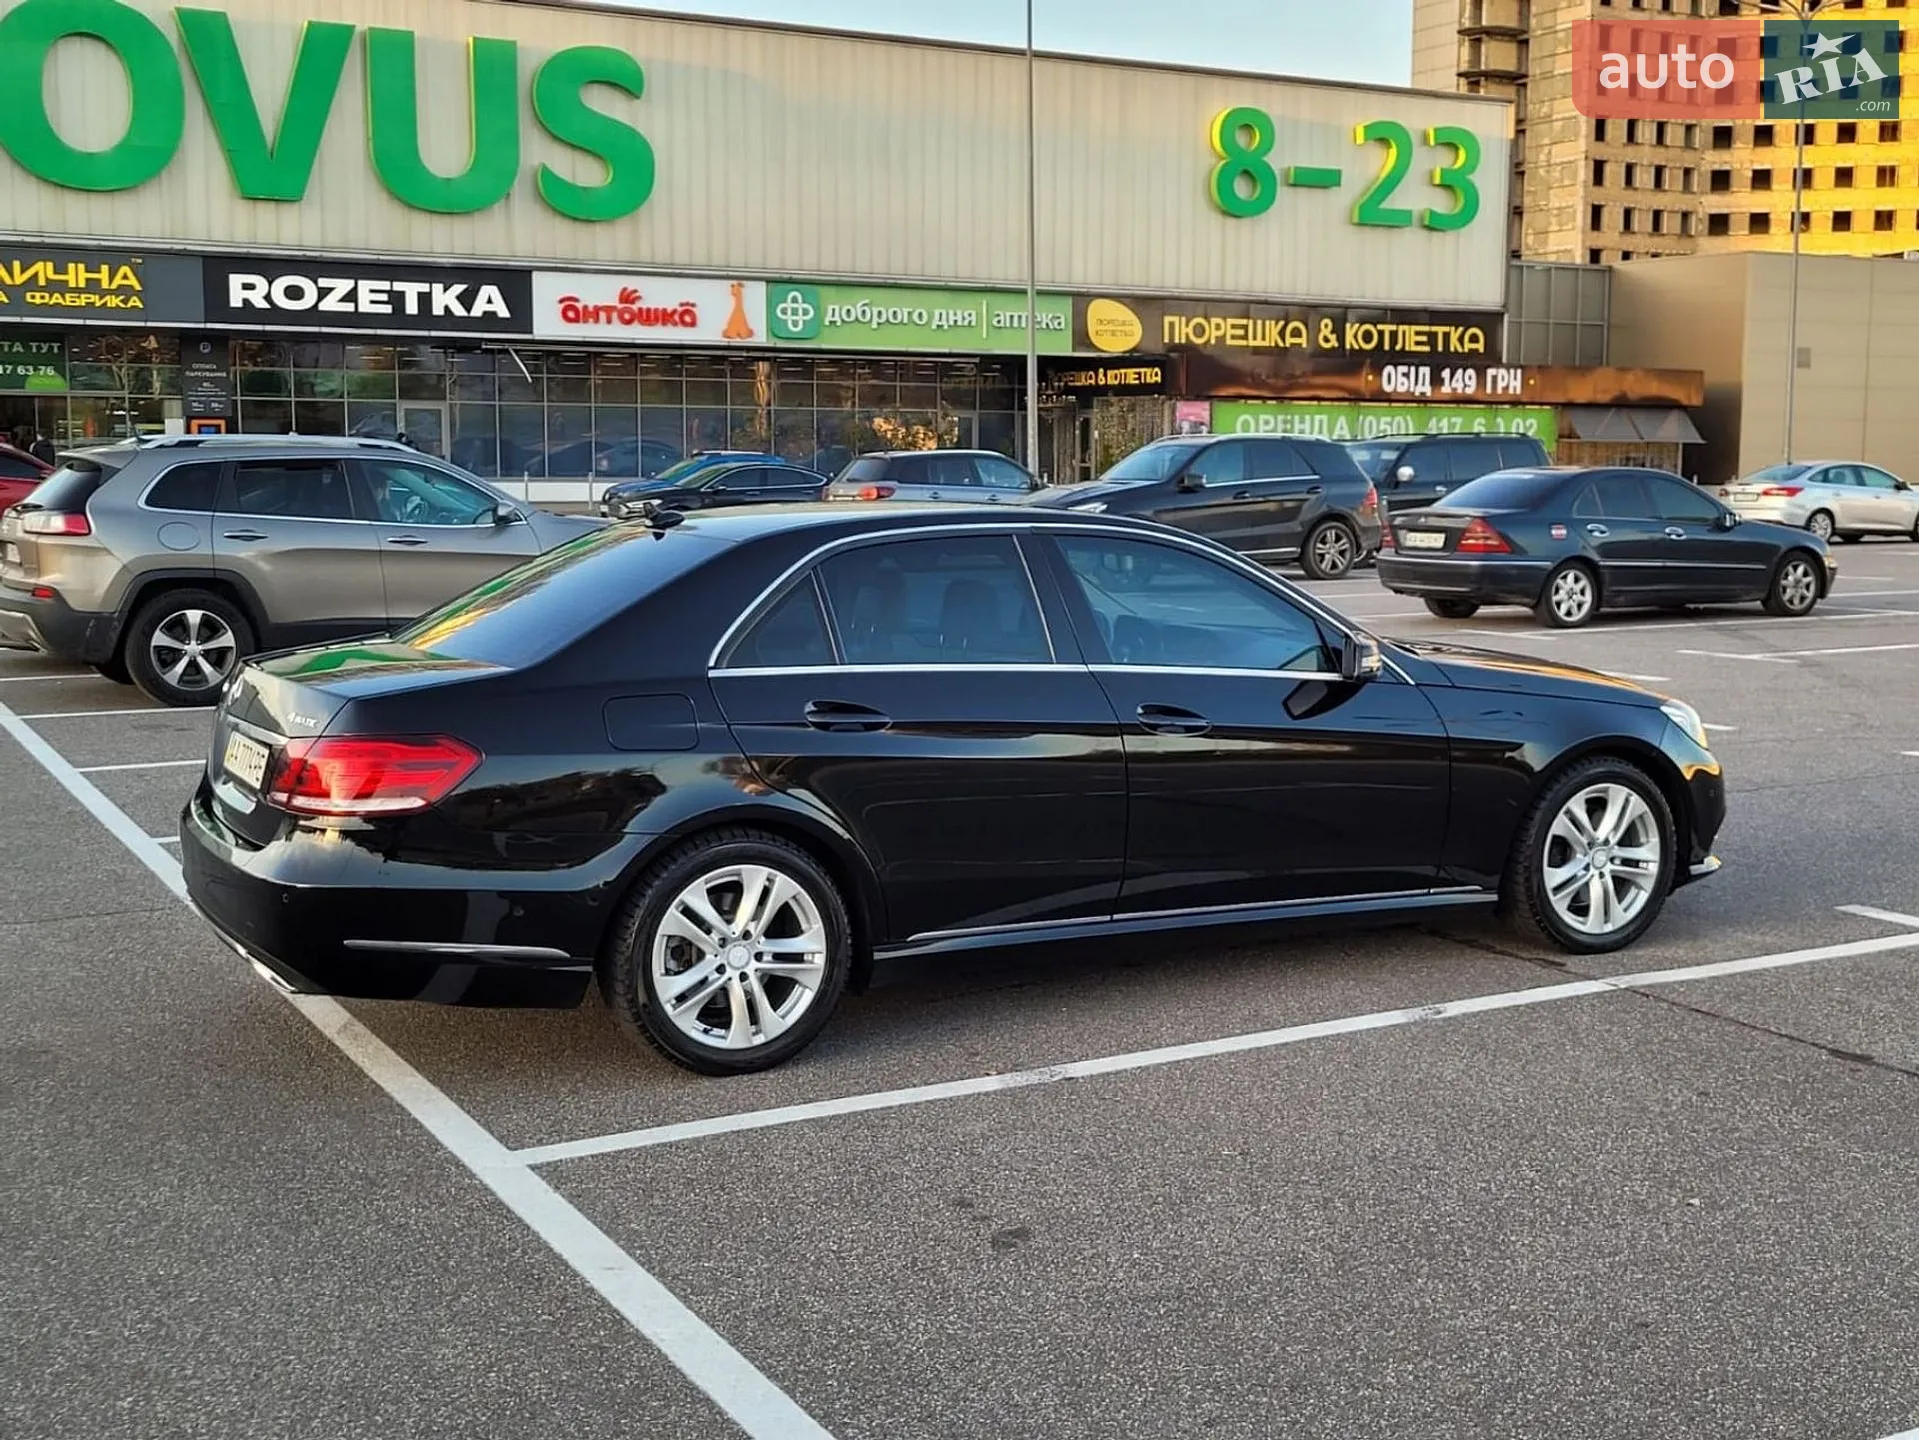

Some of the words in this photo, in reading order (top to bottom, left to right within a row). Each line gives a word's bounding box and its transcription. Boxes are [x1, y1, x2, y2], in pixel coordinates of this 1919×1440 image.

[0, 0, 655, 221] OVUS
[26, 291, 144, 308] ФАБРИКА
[228, 273, 511, 318] ROZETKA
[825, 300, 928, 328] доброго
[931, 308, 977, 329] дня
[992, 309, 1066, 330] аптека
[29, 342, 62, 353] ТУТ
[1163, 315, 1308, 348] ПЮРЕШКА
[1318, 318, 1339, 349] &
[1345, 321, 1485, 353] КОТЛЕТКА
[1106, 367, 1162, 385] КОТЛЕТКА
[1381, 365, 1432, 396] ОБІД
[1440, 367, 1477, 394] 149
[1485, 368, 1523, 394] ГРН
[1235, 413, 1351, 440] ОРЕНДА
